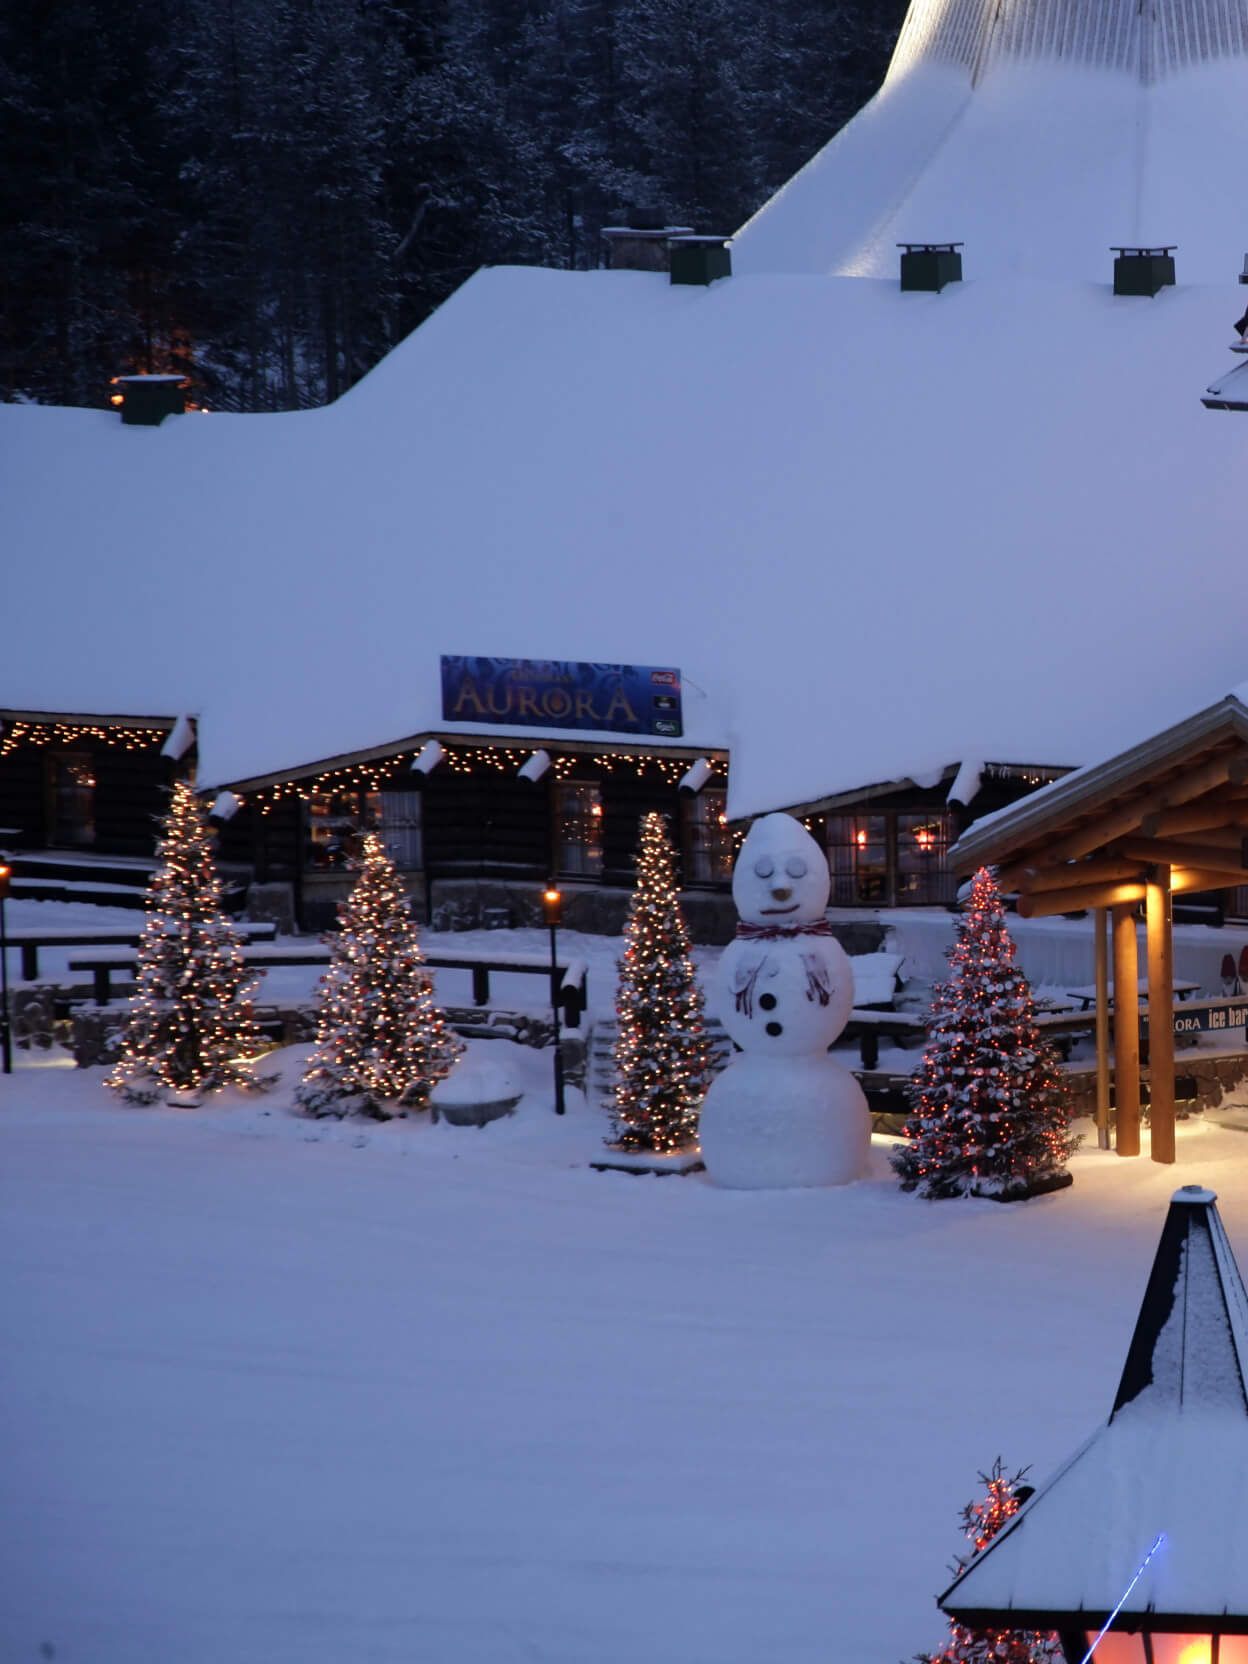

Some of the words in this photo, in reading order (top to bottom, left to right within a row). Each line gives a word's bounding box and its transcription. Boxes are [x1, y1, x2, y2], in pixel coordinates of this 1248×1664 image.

[454, 677, 639, 722] AURORA
[1209, 1008, 1226, 1029] ice
[1229, 1007, 1248, 1027] bar
